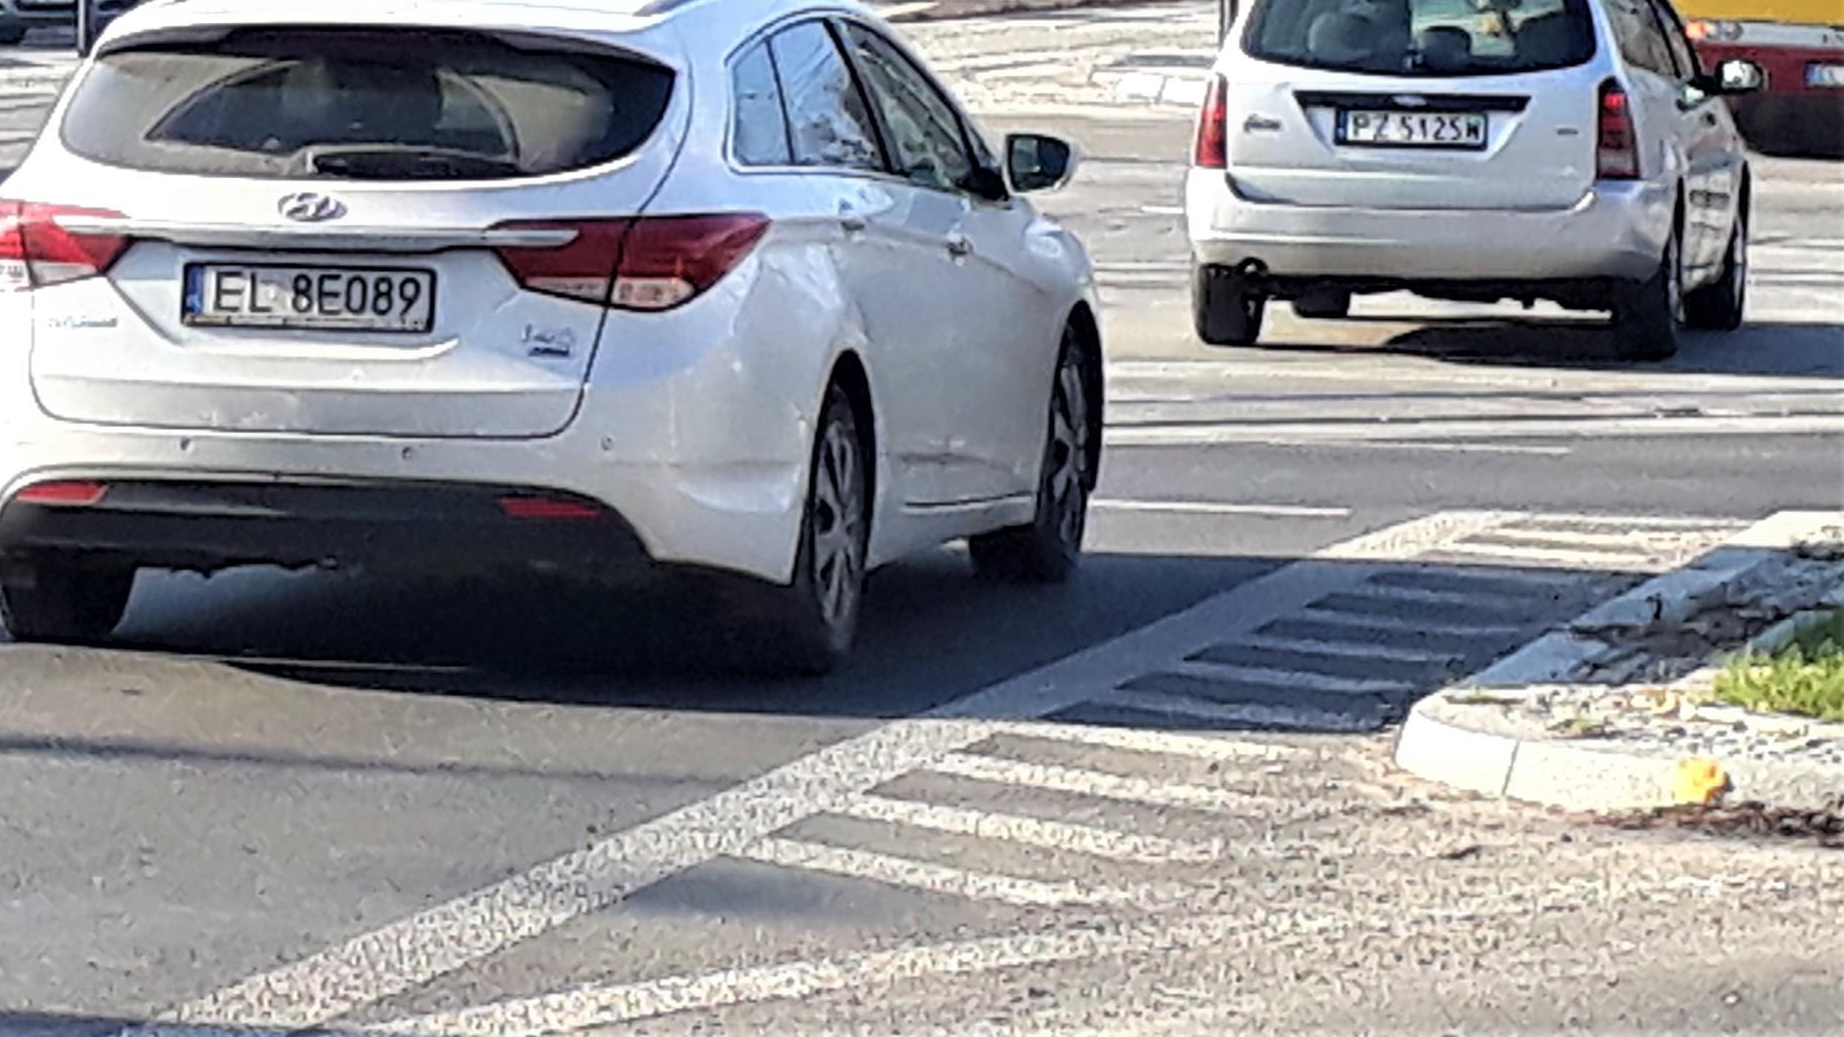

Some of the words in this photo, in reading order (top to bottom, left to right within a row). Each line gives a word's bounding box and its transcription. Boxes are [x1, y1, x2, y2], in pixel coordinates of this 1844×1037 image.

[1353, 112, 1389, 141] PZ
[212, 271, 273, 313] EL
[291, 274, 422, 317] 8E089
